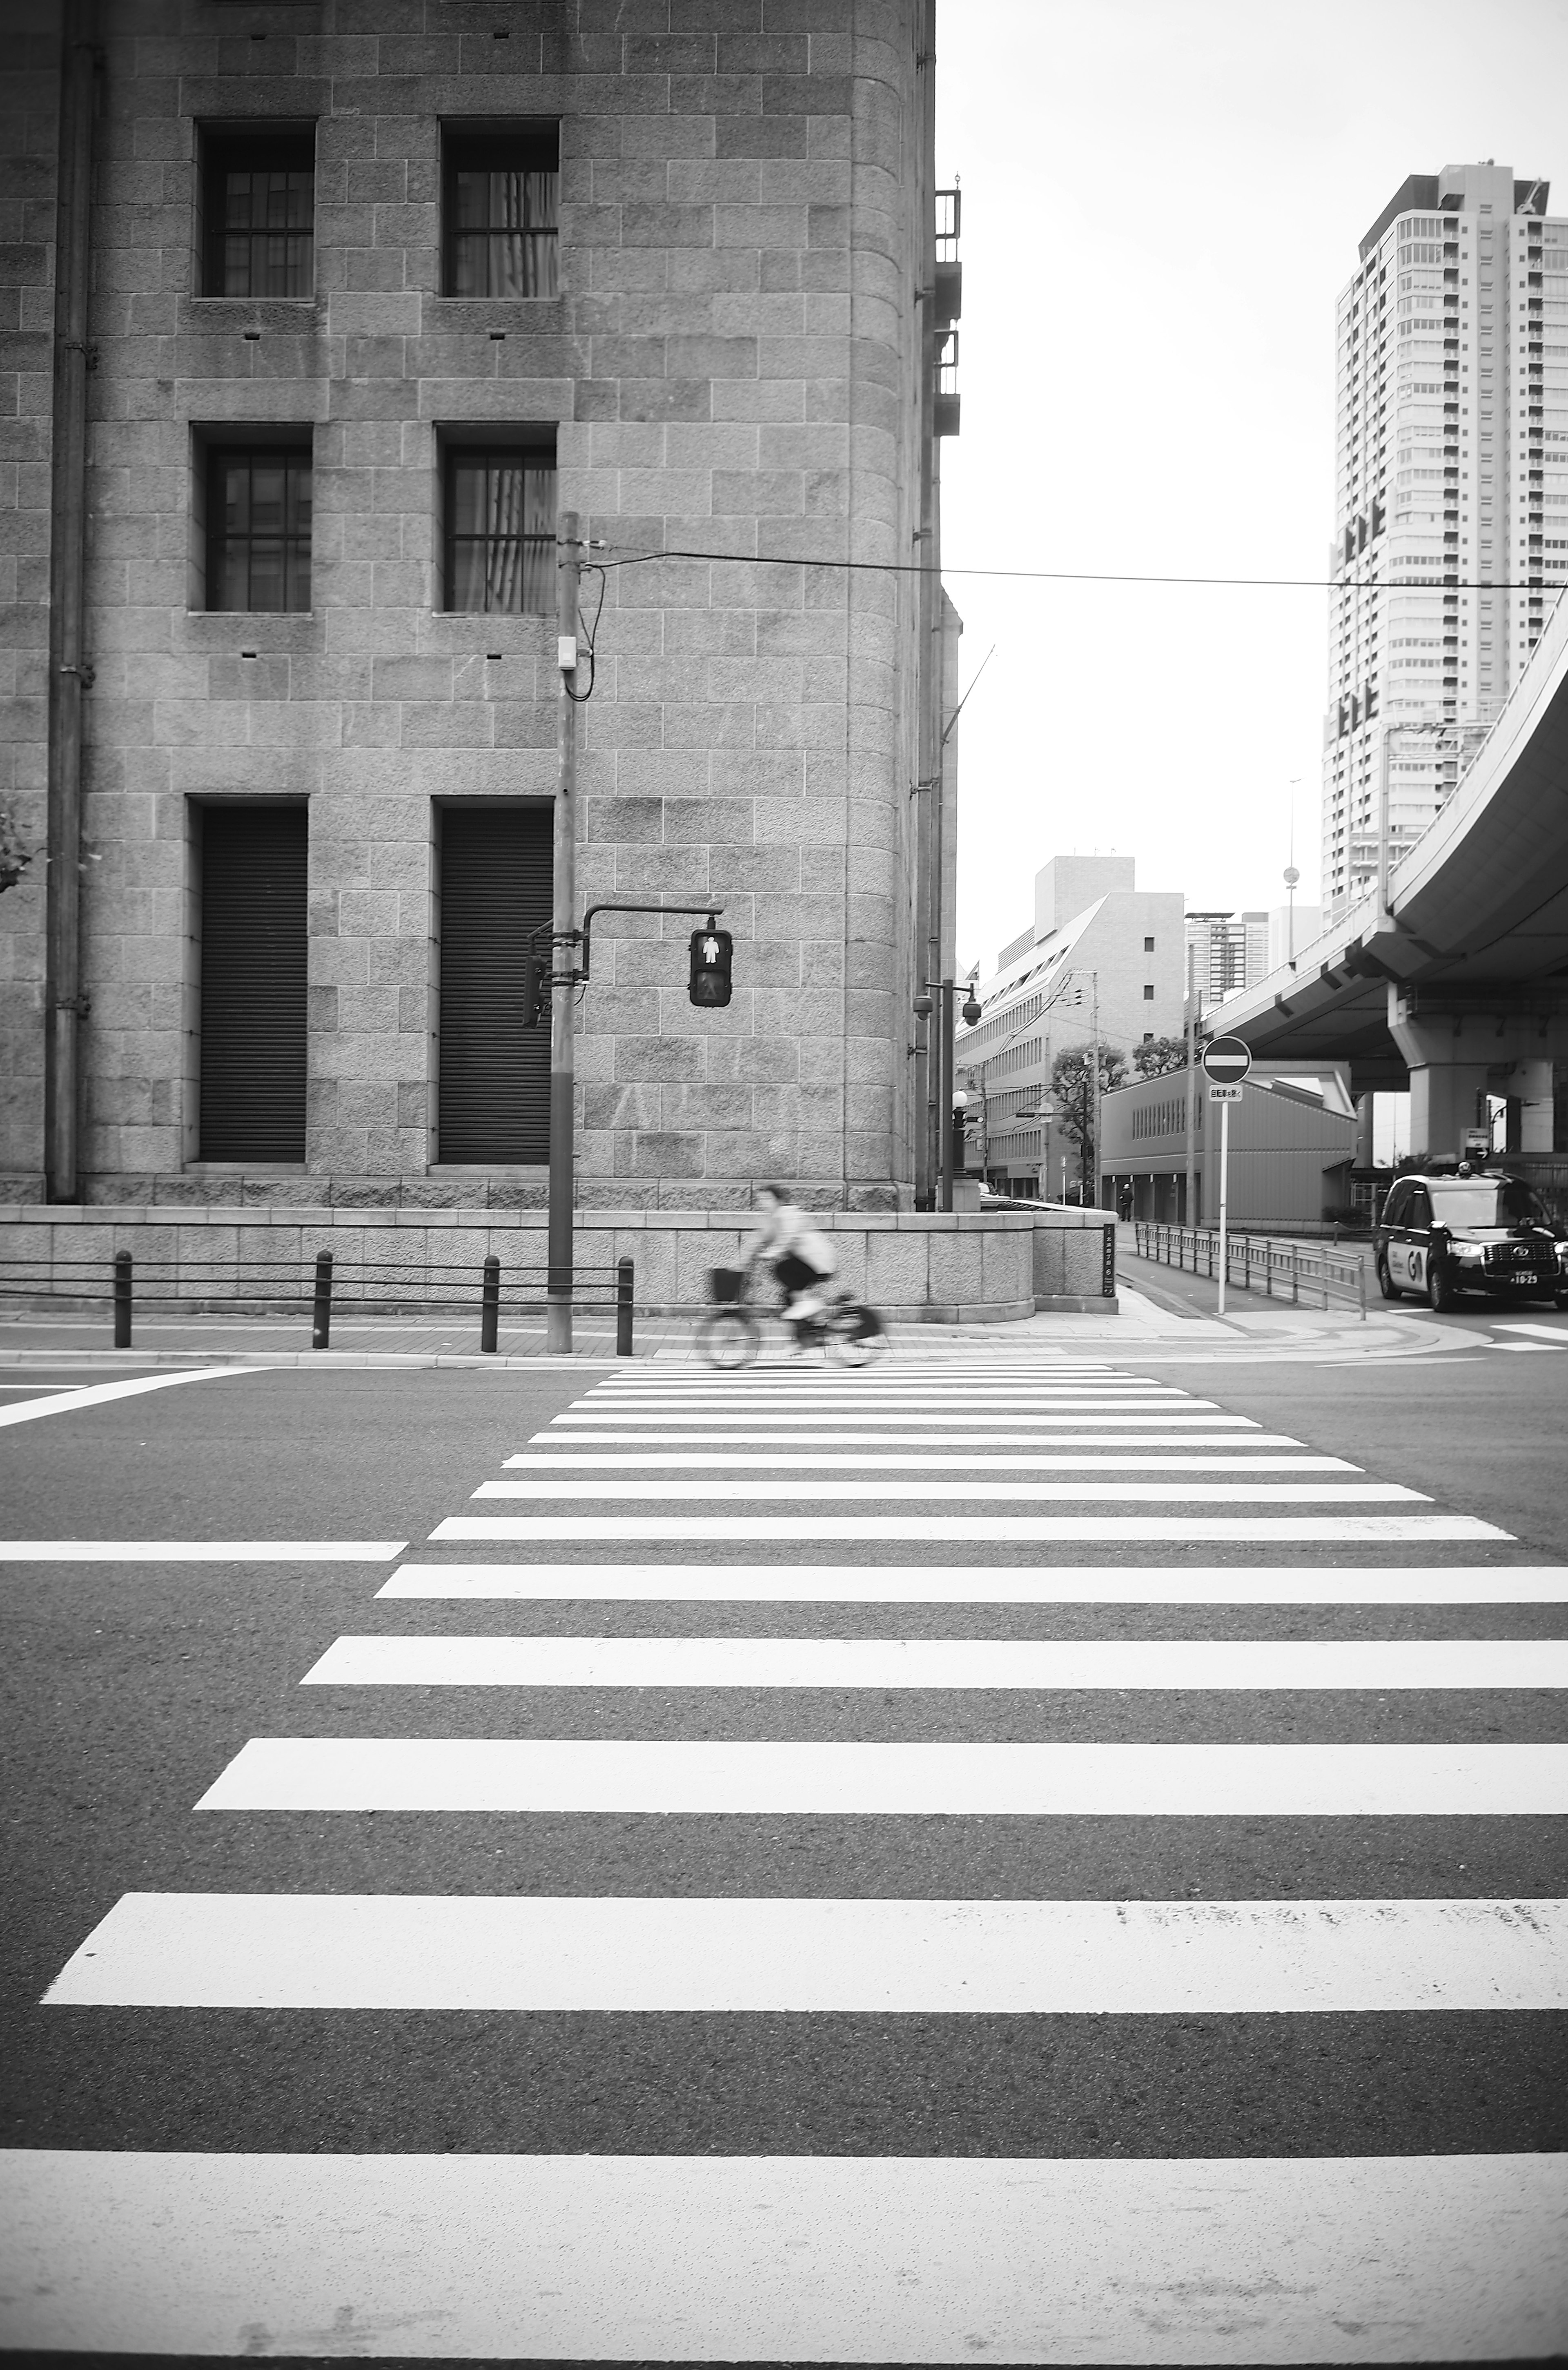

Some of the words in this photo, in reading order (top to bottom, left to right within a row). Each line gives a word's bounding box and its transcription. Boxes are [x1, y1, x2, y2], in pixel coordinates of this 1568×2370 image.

[1211, 1089, 1241, 1098] 自転車を除く
[1516, 1275, 1538, 1284] 10-29
